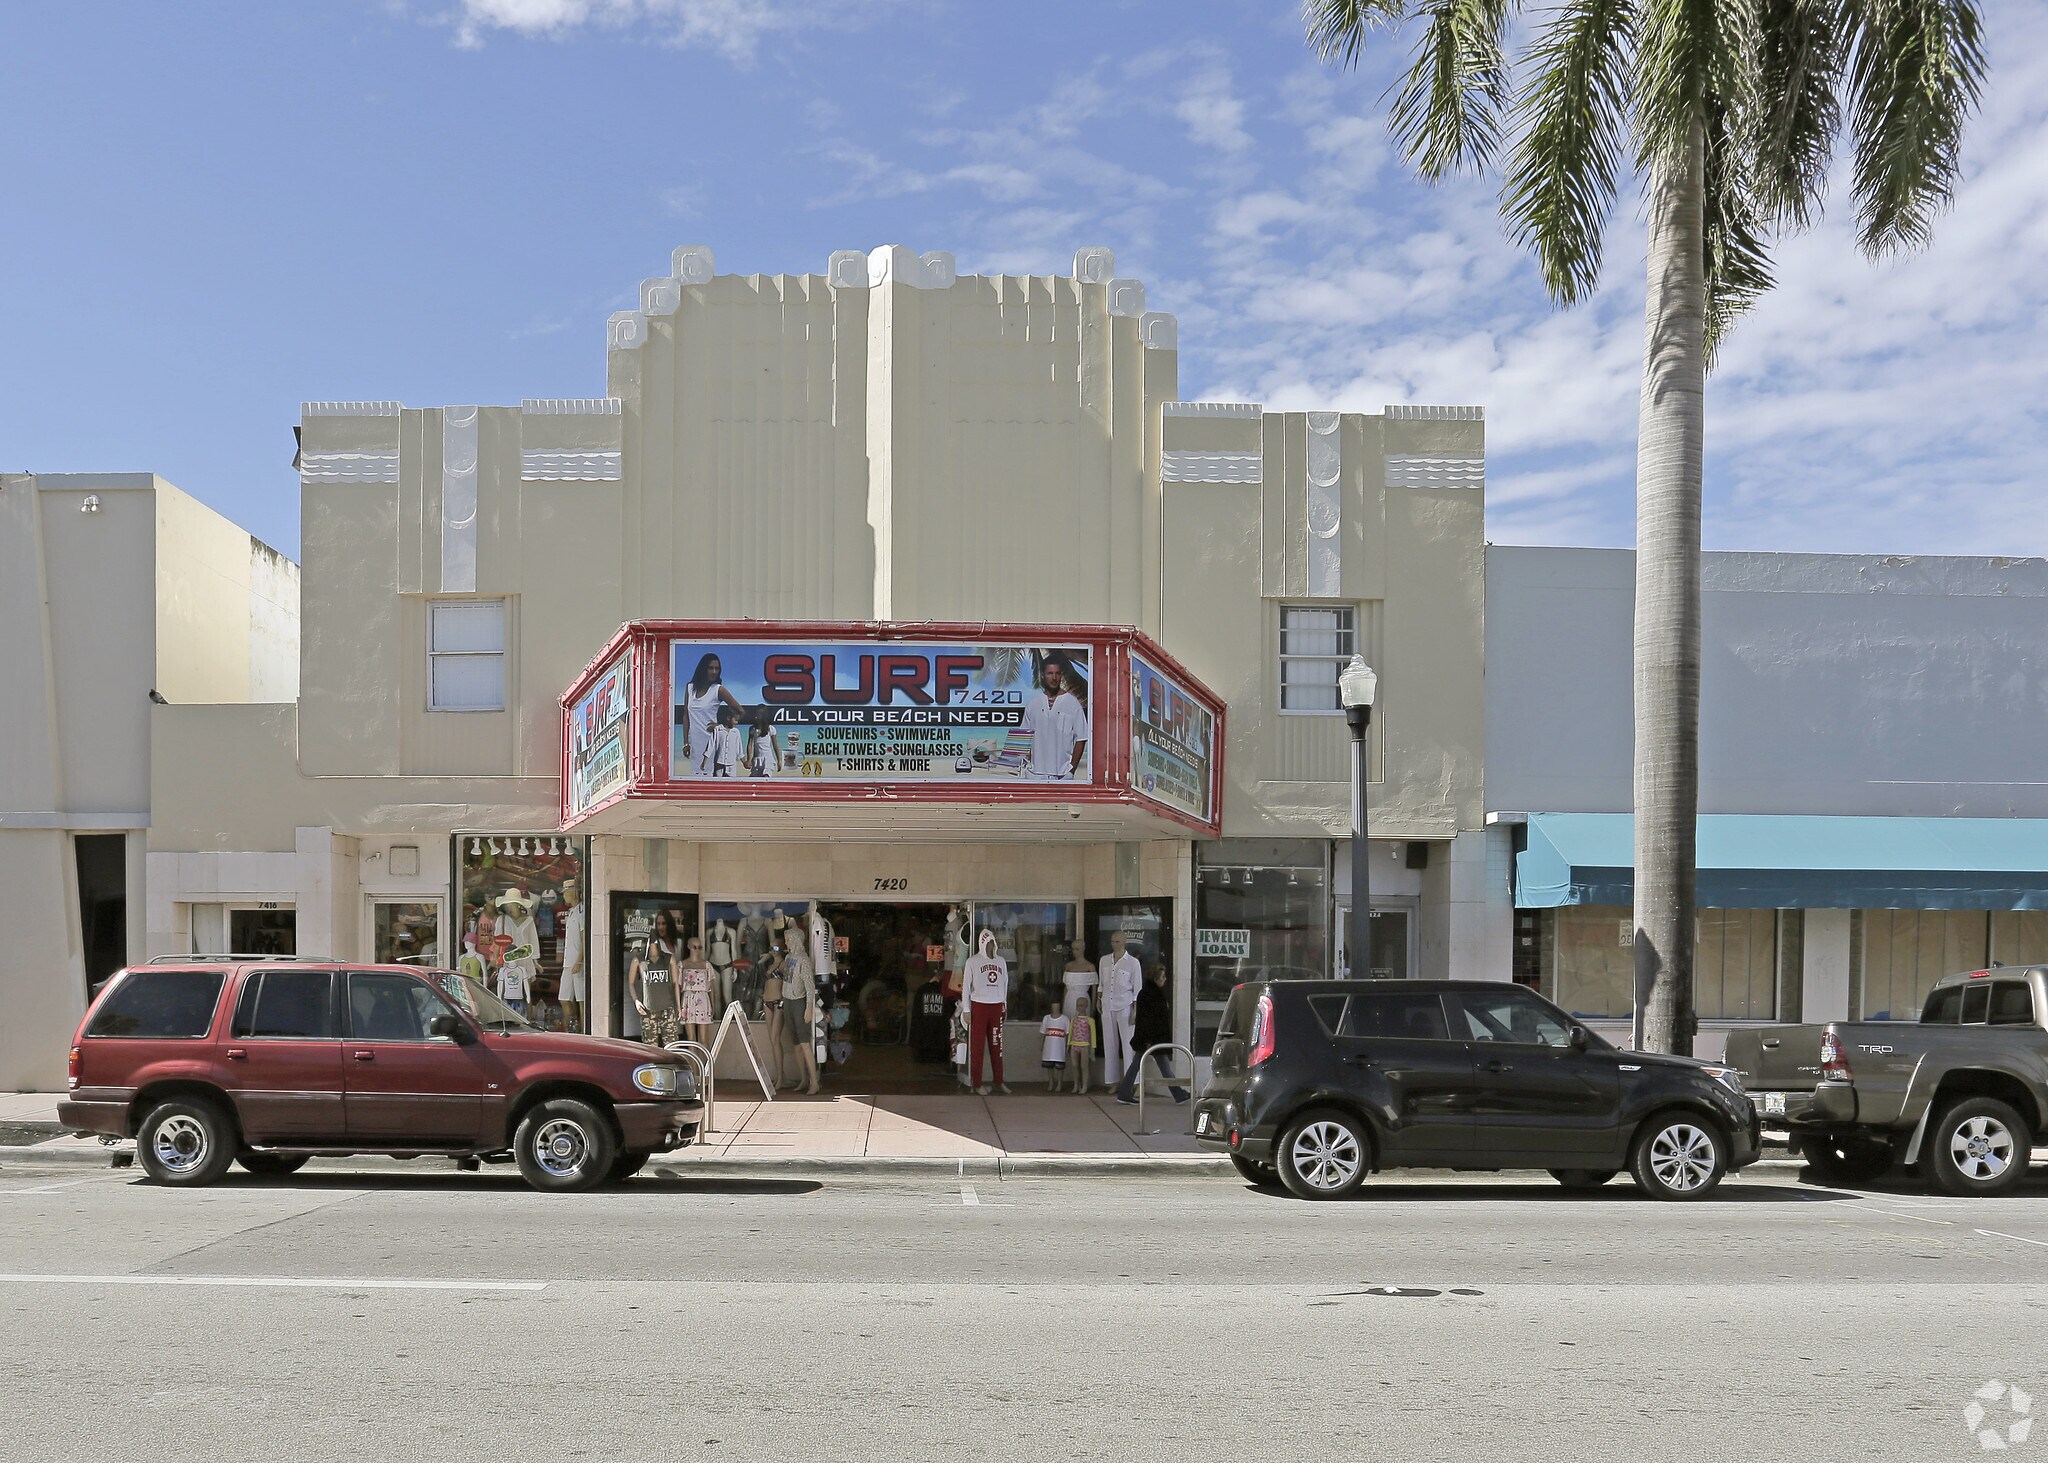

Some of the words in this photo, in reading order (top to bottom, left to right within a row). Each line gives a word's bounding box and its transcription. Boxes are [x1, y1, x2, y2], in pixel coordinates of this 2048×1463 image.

[762, 654, 984, 706] SURF
[954, 690, 1023, 704] 7420
[773, 707, 809, 722] ALL
[811, 710, 864, 722] YOUR
[873, 708, 941, 723] BEACH
[949, 711, 1020, 723] NEEDS
[817, 727, 878, 741] SOUVENIRS
[887, 728, 951, 741] SWIMWEAR
[804, 743, 840, 756] BEACH
[844, 743, 886, 757] TOWELS
[893, 743, 963, 757] SUNGLASSES
[837, 758, 885, 772] T-SHIRTS
[888, 759, 896, 772] &
[899, 759, 931, 772] MORE
[874, 879, 908, 891] 7420
[1199, 930, 1249, 943] JEWELRY
[1202, 944, 1245, 955] LOANS
[1858, 1044, 1893, 1054] TRD
